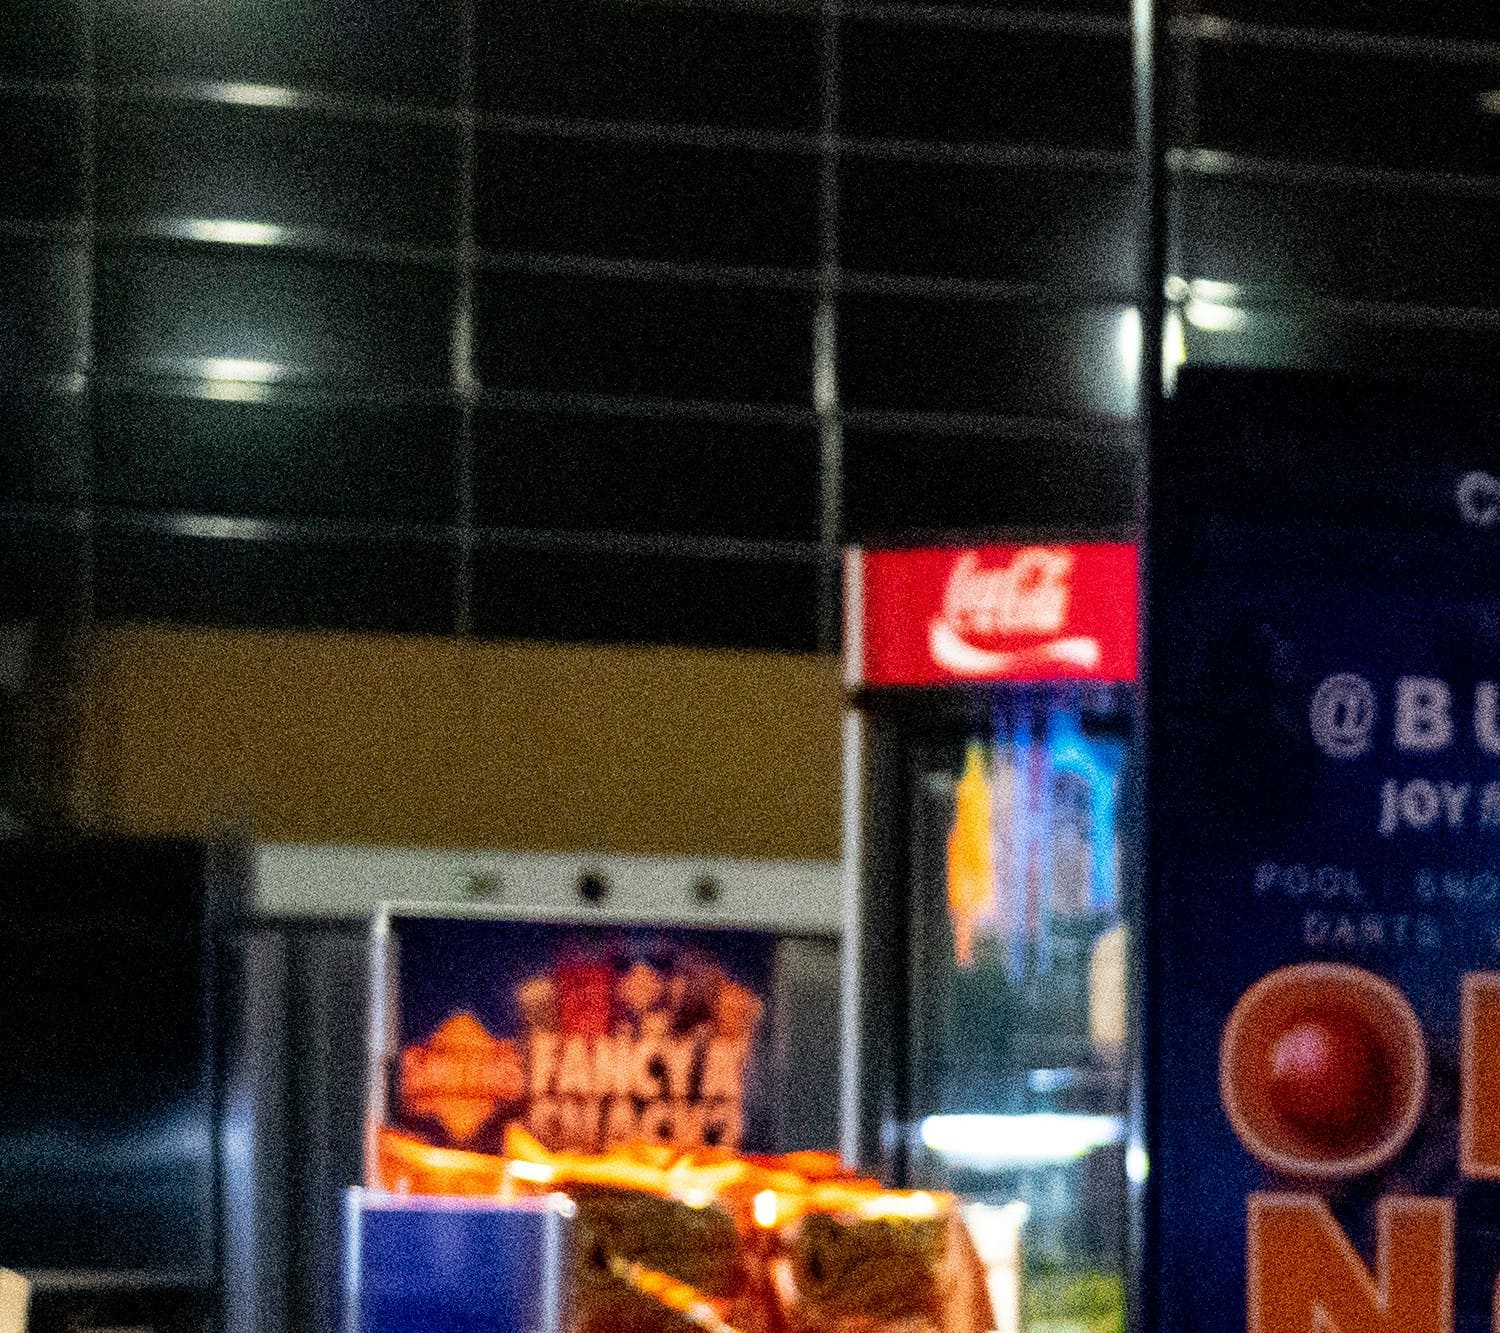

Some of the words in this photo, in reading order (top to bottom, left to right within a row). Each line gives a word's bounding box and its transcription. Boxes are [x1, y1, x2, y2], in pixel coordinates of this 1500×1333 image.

[1376, 779, 1471, 838] JOY
[1253, 862, 1365, 903] POOL
[1301, 911, 1441, 950] DARTS
